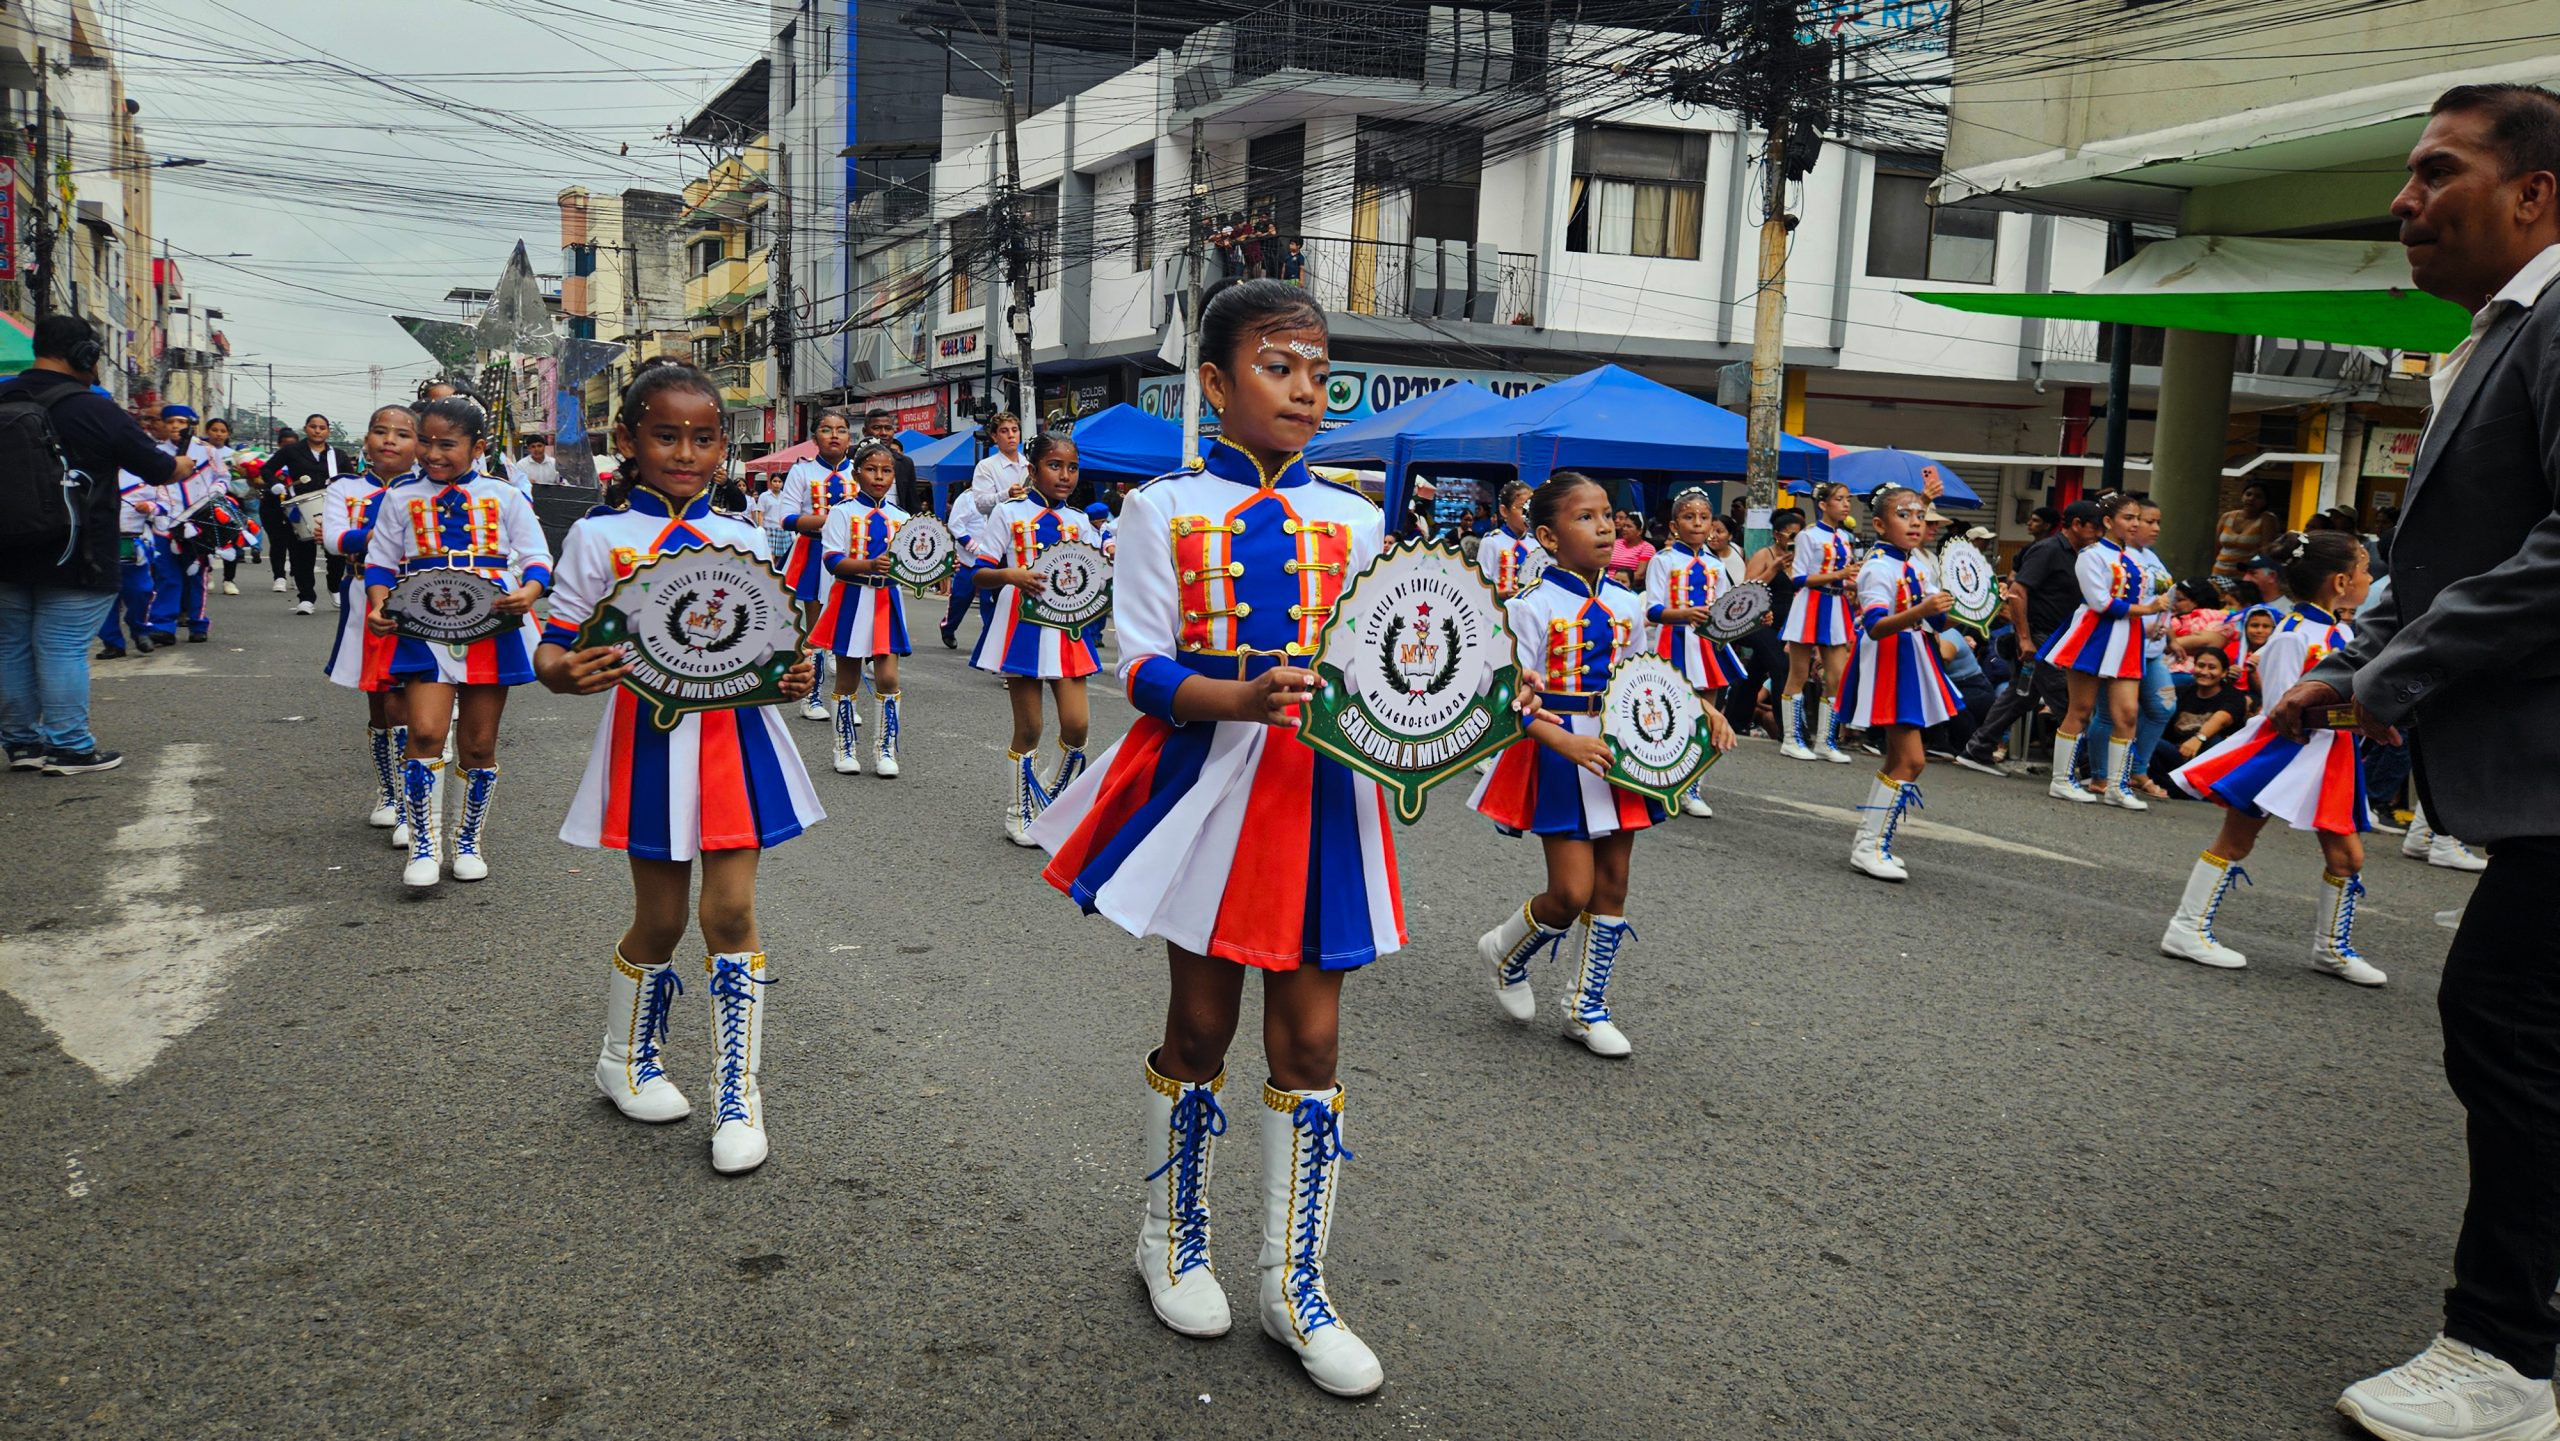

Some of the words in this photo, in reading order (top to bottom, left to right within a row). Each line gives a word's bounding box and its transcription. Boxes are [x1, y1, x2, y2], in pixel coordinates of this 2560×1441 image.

[1081, 385, 1107, 398] GOLDEN
[1371, 374, 1473, 414] OPT
[655, 574, 692, 606] ESCUELA
[1035, 605, 1067, 623] SALUDA
[1067, 613, 1075, 623] A
[1075, 594, 1108, 621] MILAGRO
[1364, 594, 1394, 645] ESCUELA
[404, 620, 446, 639] SALUDA
[447, 630, 456, 639] A
[456, 617, 502, 639] MILAGRO
[664, 678, 680, 695] A
[680, 671, 760, 699] MILAGRO
[1339, 705, 1400, 766] SALUDA
[1401, 743, 1414, 768] A
[1416, 706, 1490, 767] MILAGRO
[1622, 755, 1660, 786] SALUDA
[1660, 771, 1668, 786] A
[1666, 742, 1702, 785] MILAGRO
